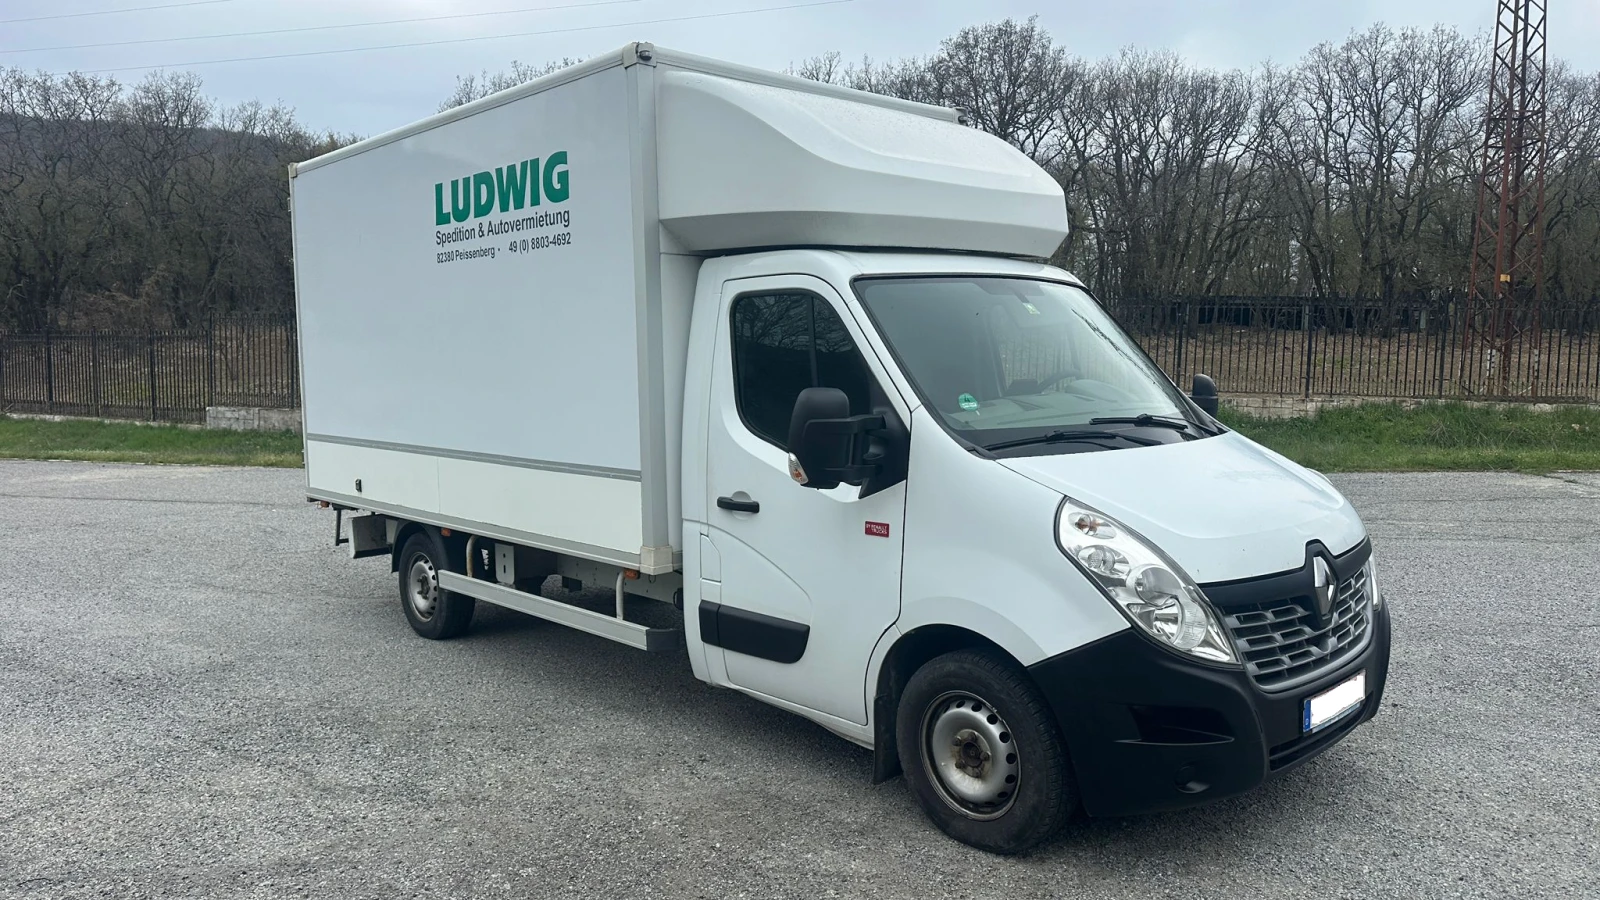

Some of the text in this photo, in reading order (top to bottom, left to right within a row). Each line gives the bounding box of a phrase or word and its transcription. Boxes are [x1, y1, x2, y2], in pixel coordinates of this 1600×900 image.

[435, 151, 569, 226] LUDWIG
[436, 210, 570, 247] Spedition & Autovermietung
[437, 232, 571, 263] 82380 Peissenberg 49 (0) 8803-4692
